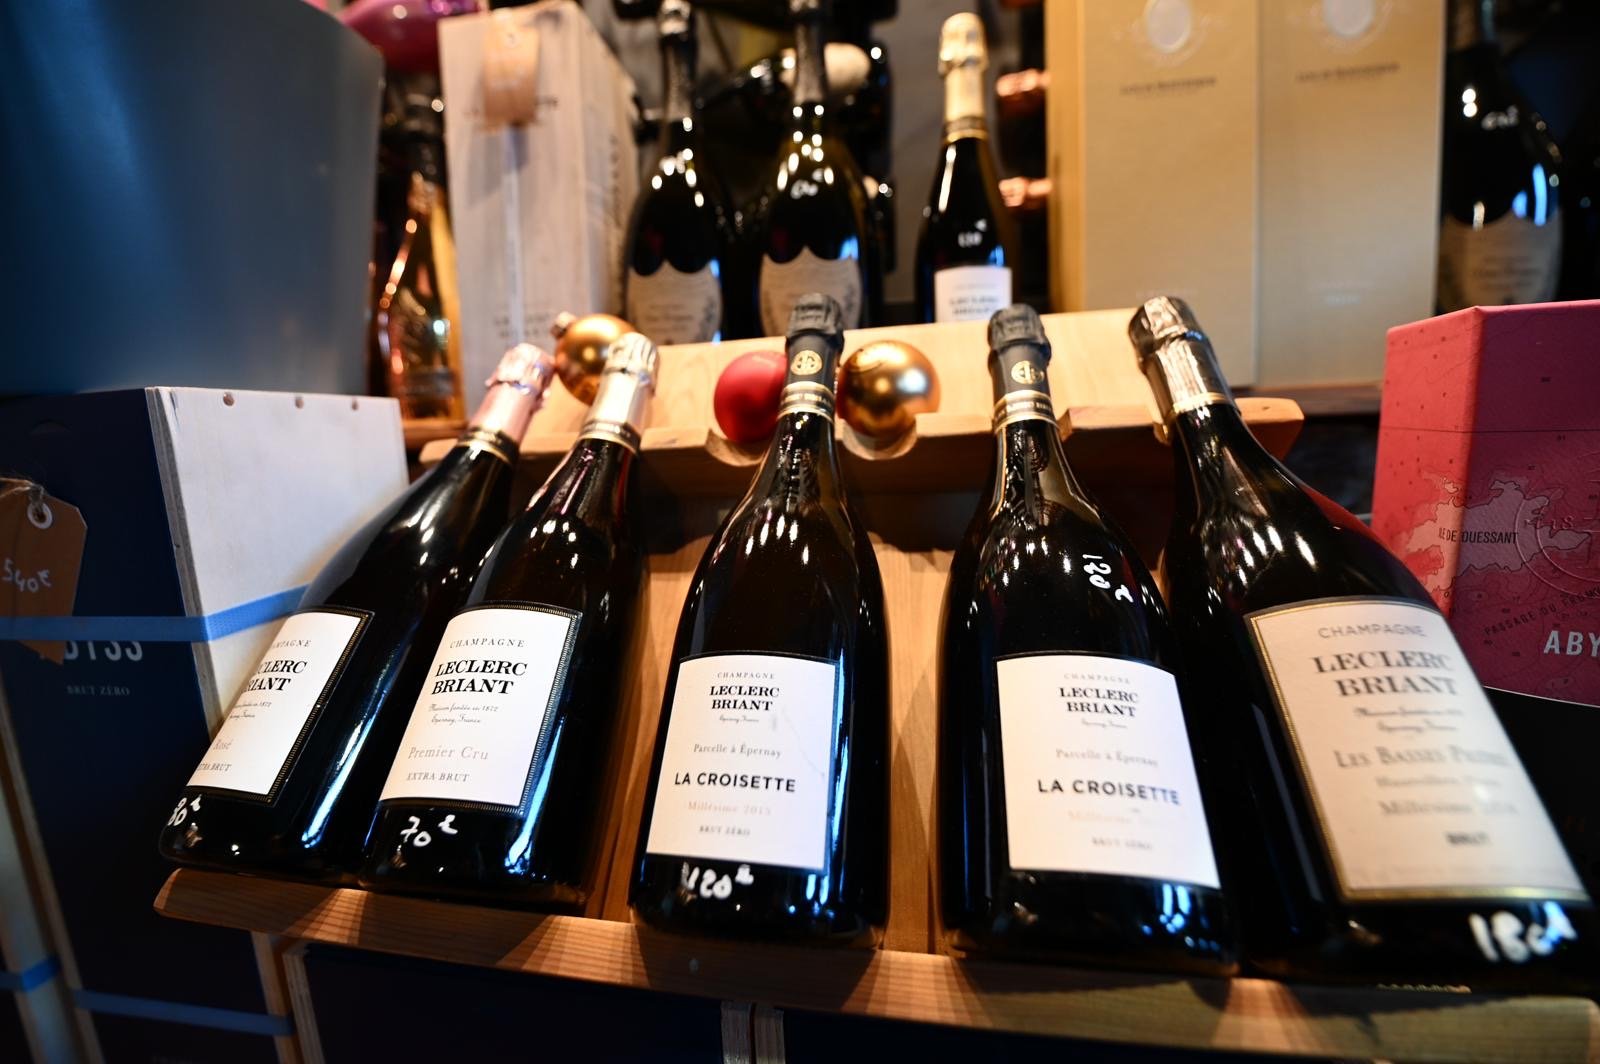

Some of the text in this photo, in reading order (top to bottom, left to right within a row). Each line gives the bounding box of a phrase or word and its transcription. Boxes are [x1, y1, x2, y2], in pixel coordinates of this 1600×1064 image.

[1461, 531, 1518, 544] OUESSANT
[1317, 623, 1426, 640] CHAMPAGNE
[449, 637, 526, 649] CHAMPAGNE
[434, 659, 528, 677] LECLERC
[1312, 650, 1453, 673] LECLERC
[716, 671, 775, 680] CHAMPAGNE
[431, 678, 515, 696] BRIANT
[709, 685, 780, 699] LECLERC
[1059, 687, 1139, 704] LECLERC
[1334, 677, 1459, 697] BRIANT
[711, 700, 773, 712] BRIANT
[1066, 701, 1138, 718] BRIANT
[407, 746, 489, 761] Premier Cru
[693, 743, 728, 754] Parcelle
[406, 772, 470, 783] EXTRA BRUT
[674, 773, 796, 793] LA CROISETTE
[1037, 779, 1181, 806] LA CROISETTE
